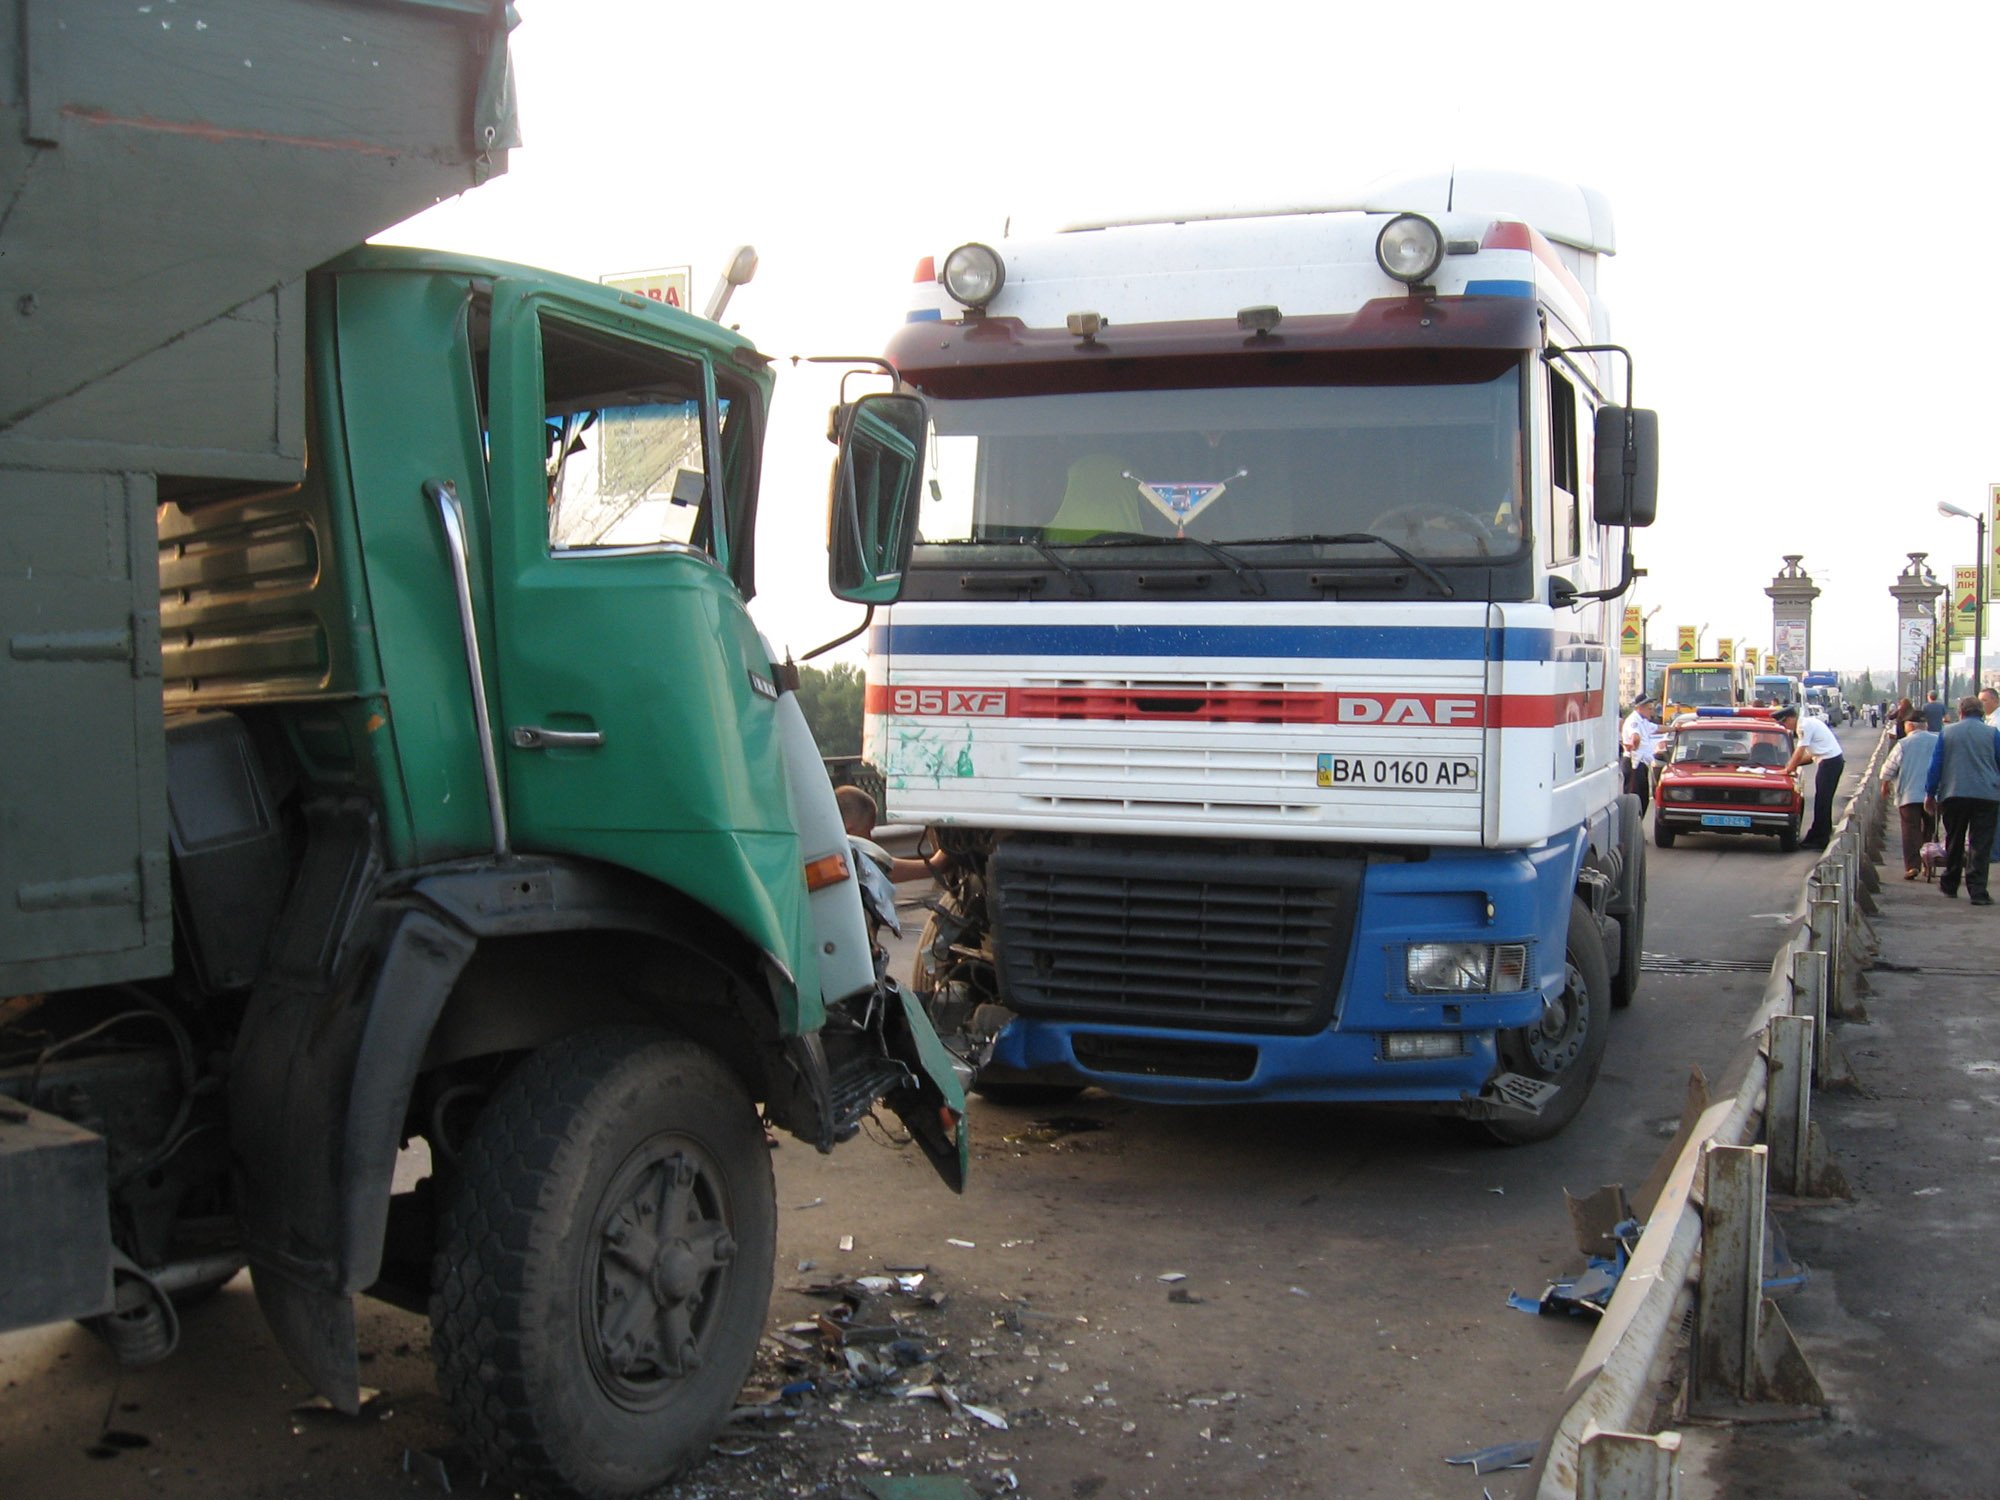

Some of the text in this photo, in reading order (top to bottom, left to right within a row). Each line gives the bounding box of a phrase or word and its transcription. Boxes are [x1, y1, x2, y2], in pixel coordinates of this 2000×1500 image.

[894, 689, 943, 714] 95
[1337, 697, 1477, 724] DAF
[1333, 759, 1470, 786] BA 0160 AP
